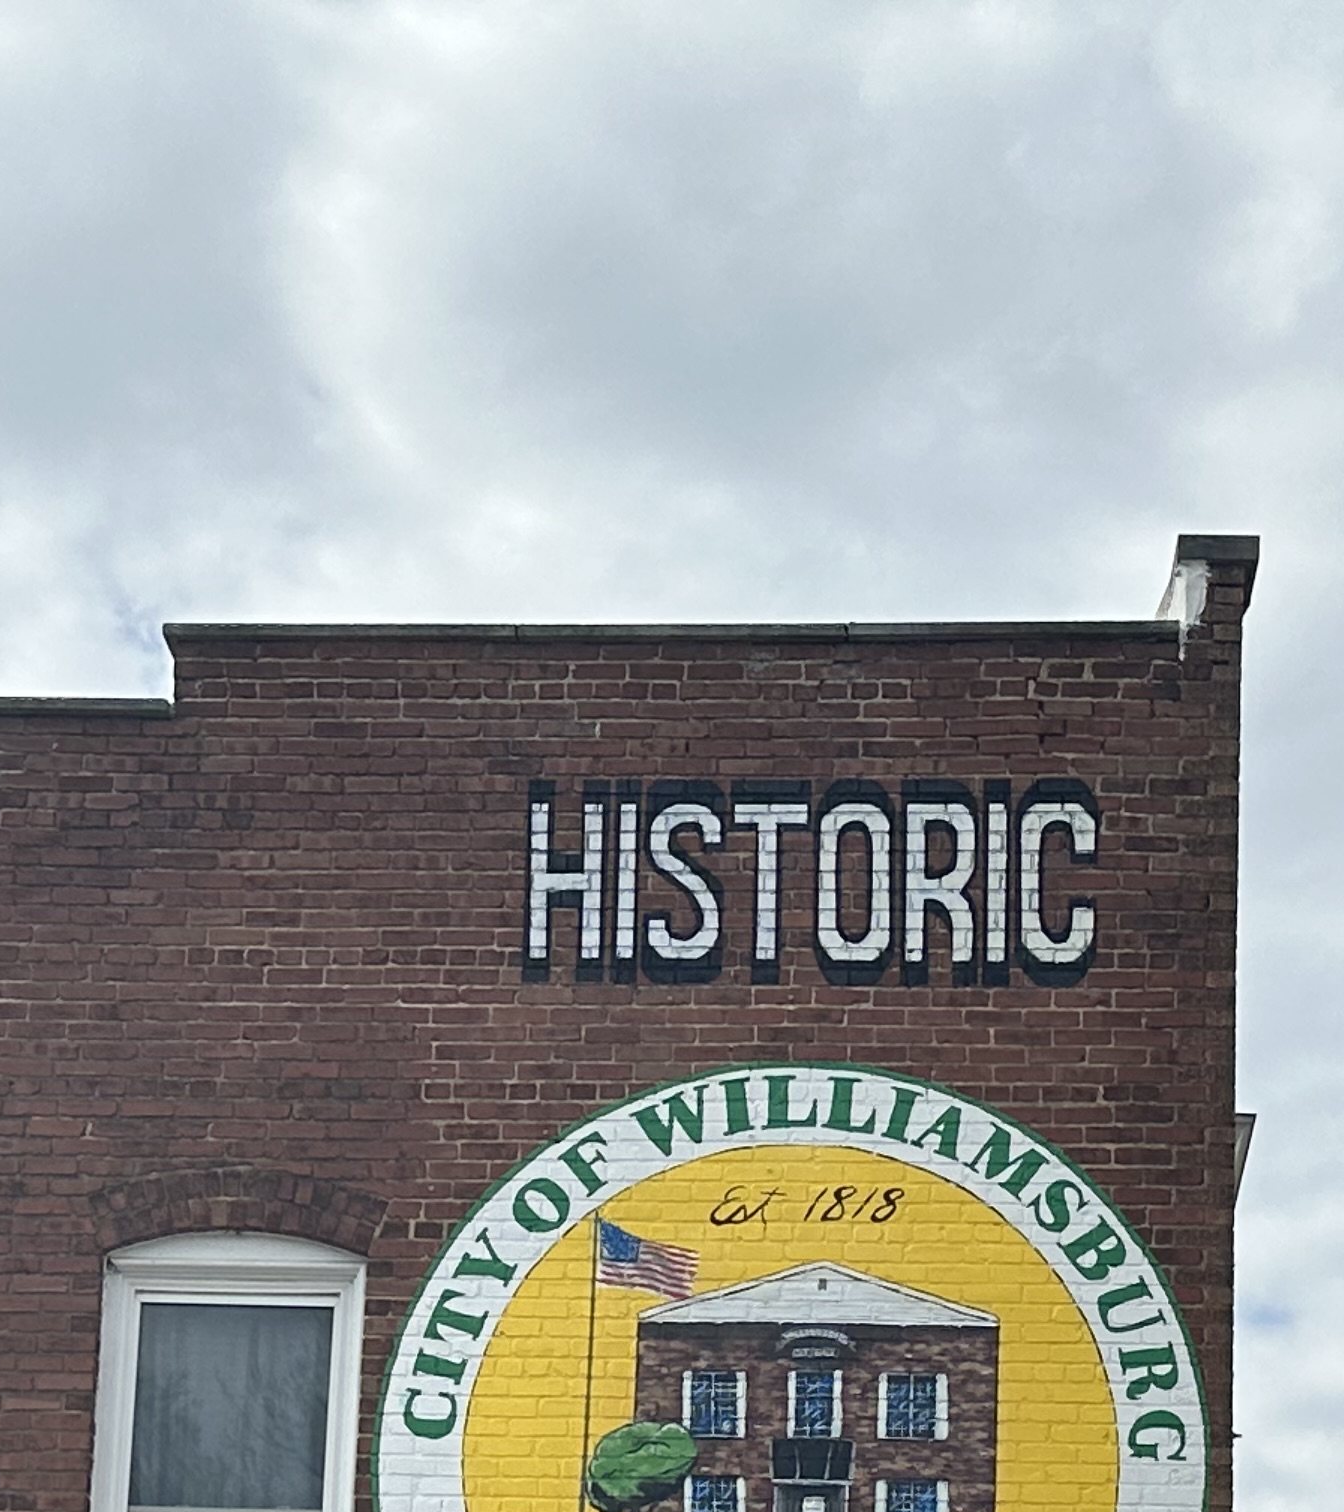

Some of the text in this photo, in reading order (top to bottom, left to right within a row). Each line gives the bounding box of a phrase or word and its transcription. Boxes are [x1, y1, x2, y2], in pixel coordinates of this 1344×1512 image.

[524, 792, 1100, 970] HISTORIC
[403, 1074, 1187, 1462] CITY OF WILLIAMSBURG
[710, 1184, 906, 1232] Est 1818
